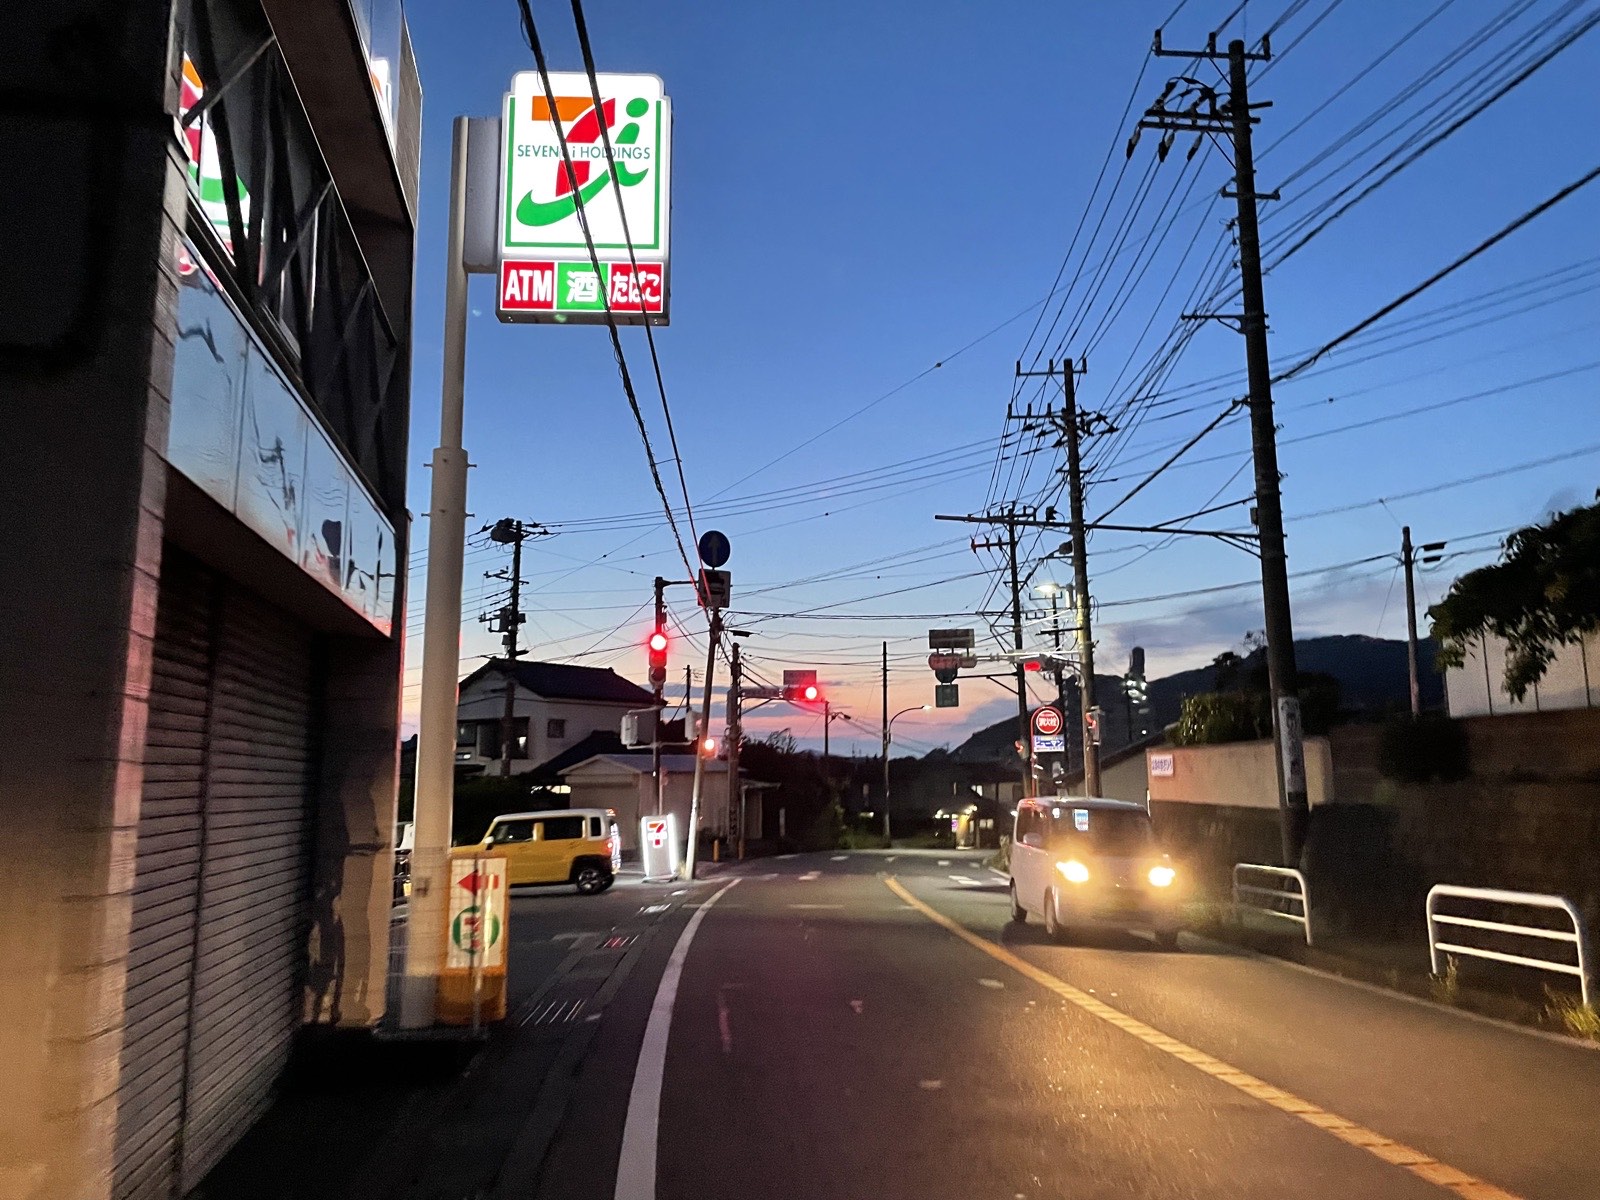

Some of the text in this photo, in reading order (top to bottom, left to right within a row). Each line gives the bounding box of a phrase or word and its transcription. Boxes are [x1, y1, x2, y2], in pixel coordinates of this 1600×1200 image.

[580, 146, 650, 159] HOLDINGS
[505, 269, 552, 302] ATM
[566, 271, 599, 303] 酒
[612, 271, 660, 303] たばこ
